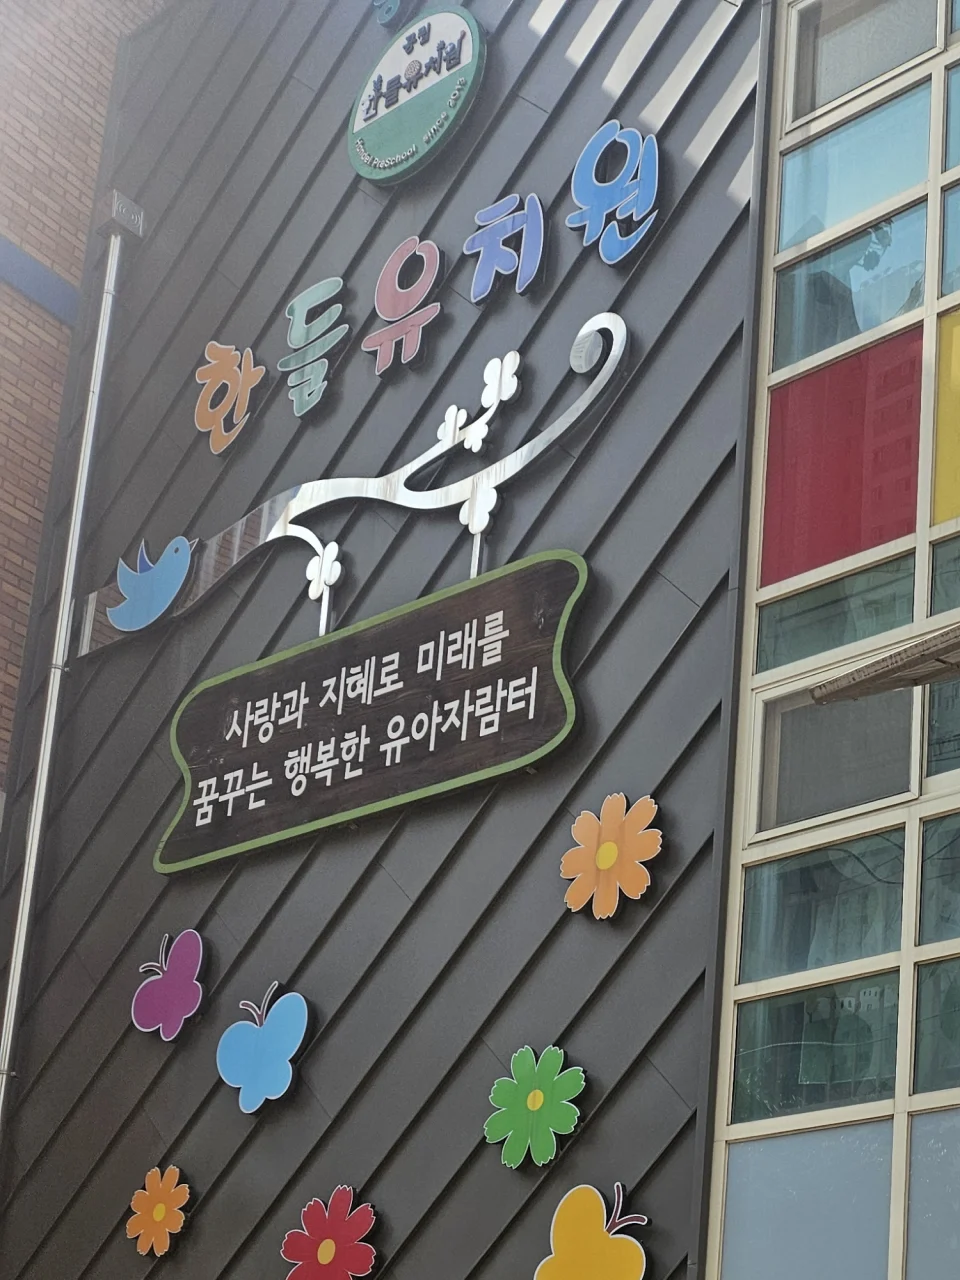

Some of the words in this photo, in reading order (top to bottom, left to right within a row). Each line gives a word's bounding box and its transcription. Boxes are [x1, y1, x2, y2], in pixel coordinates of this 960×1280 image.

[194, 119, 660, 455] 한들유치원
[193, 762, 273, 827] 꿈꾸는
[284, 725, 370, 797] 행복한
[379, 666, 539, 767] 유아자람터
[225, 681, 308, 748] 사랑과
[318, 652, 403, 715] 지혜로
[416, 610, 510, 681] 미래를
